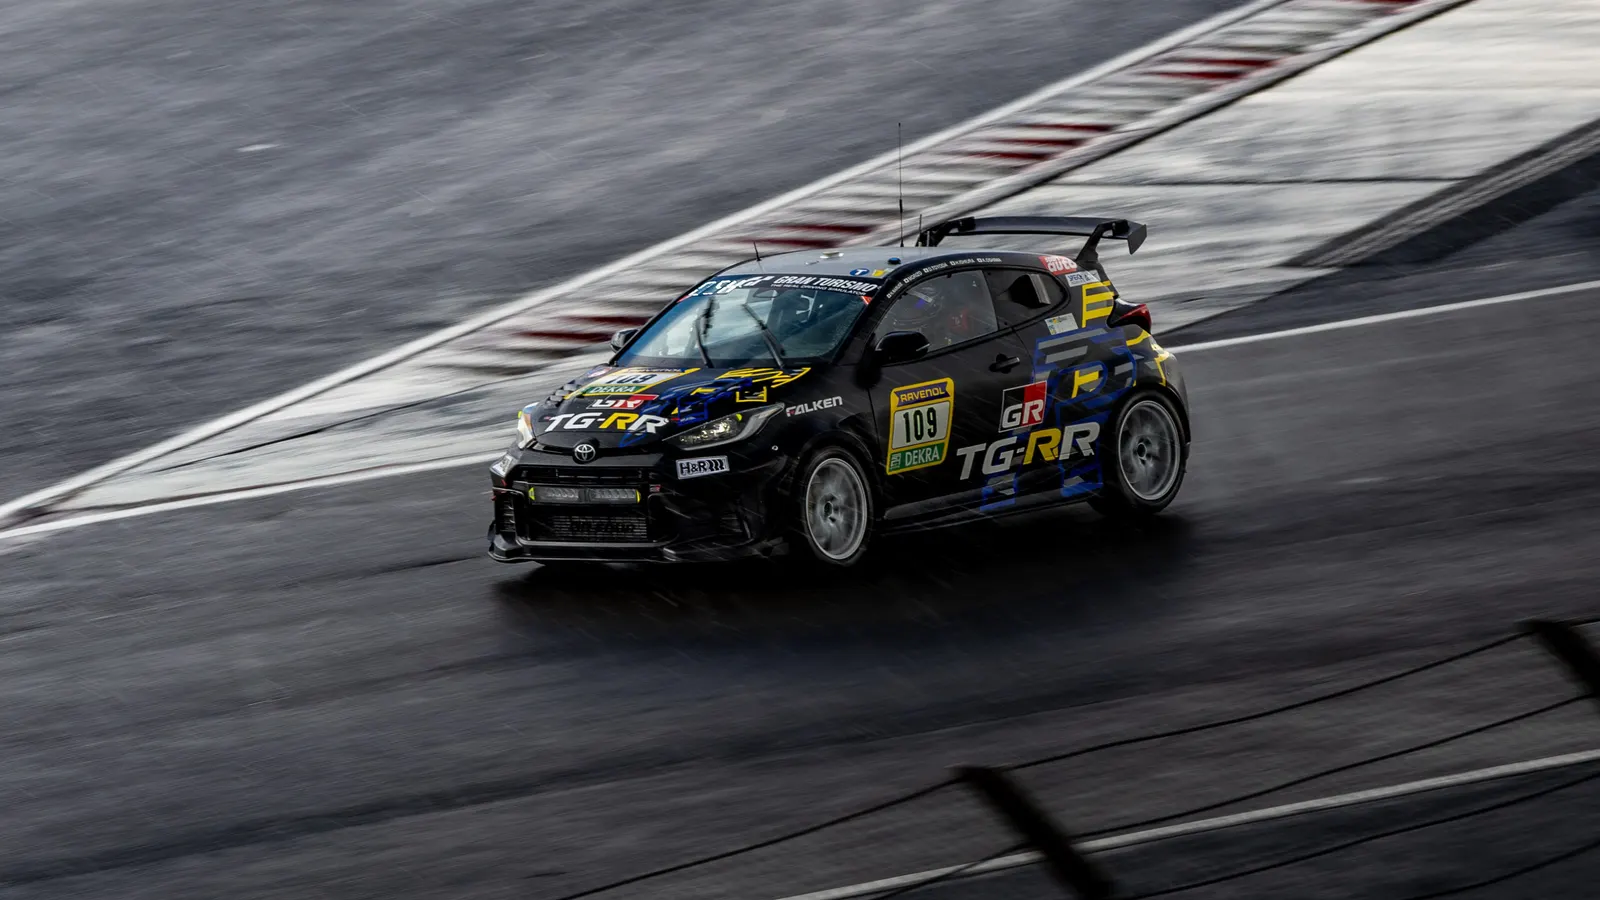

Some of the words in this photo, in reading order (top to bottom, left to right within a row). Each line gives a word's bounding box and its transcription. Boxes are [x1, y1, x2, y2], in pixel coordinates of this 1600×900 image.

[773, 276, 817, 285] GRAN
[813, 278, 878, 292] TURISMO
[828, 287, 867, 296] SIMULATOR
[606, 373, 658, 384] 109
[592, 399, 644, 408] GR
[900, 387, 946, 402] RAVENOL
[785, 396, 843, 417] FALKEN
[1002, 399, 1044, 429] GR
[545, 412, 669, 434] TG-RR
[903, 407, 938, 443] 109
[905, 445, 940, 467] DEKRA
[956, 421, 1100, 481] TG-RR
[679, 461, 707, 475] H&R
